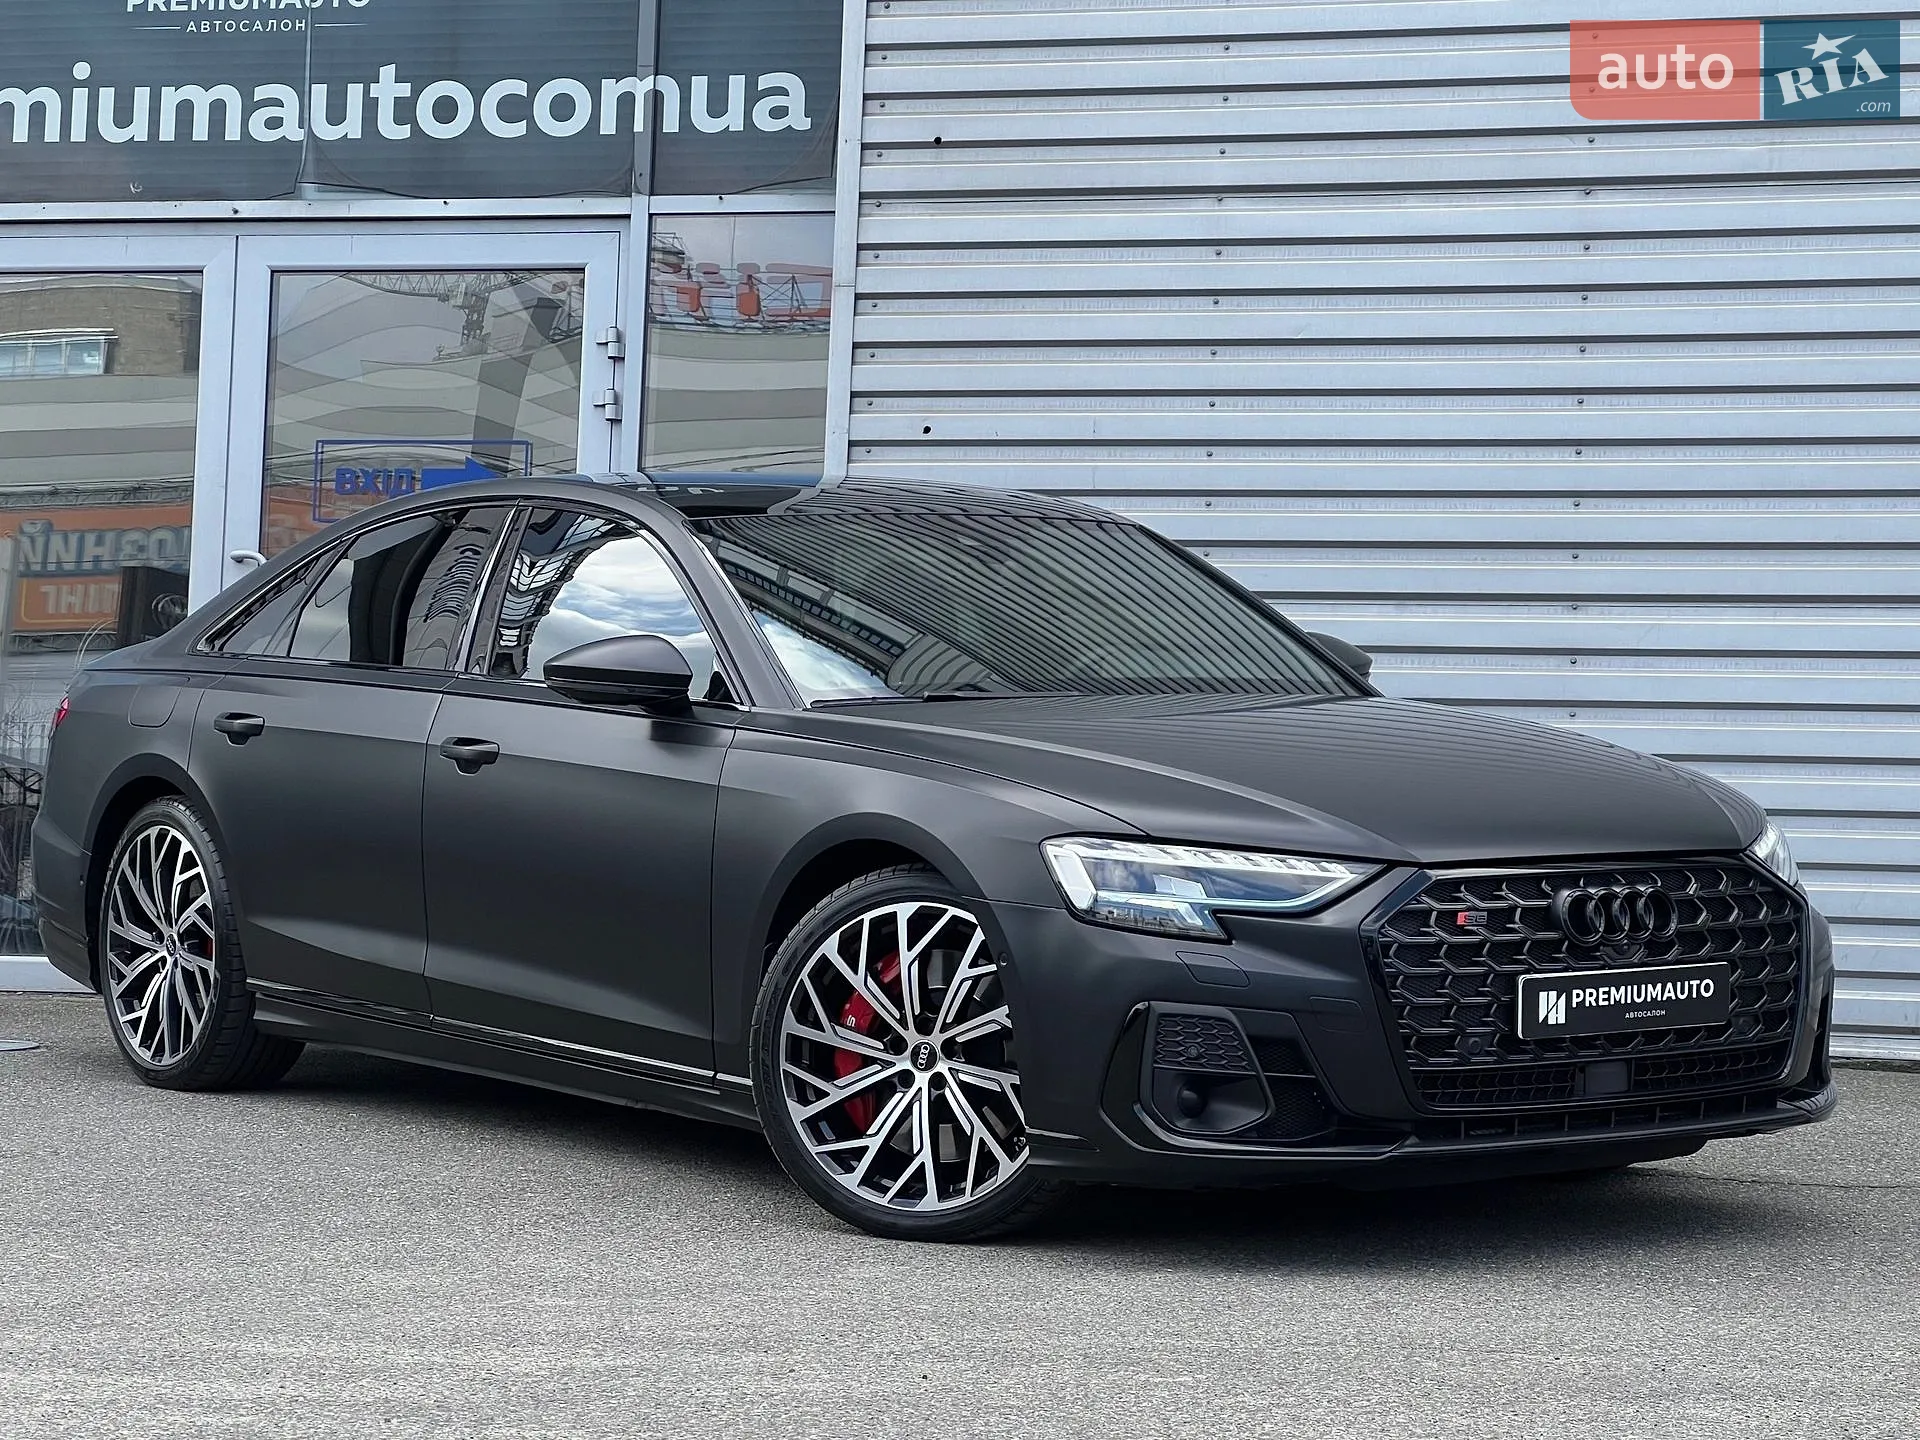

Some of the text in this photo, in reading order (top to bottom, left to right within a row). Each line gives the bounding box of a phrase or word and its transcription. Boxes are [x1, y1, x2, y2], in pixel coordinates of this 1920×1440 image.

[186, 19, 306, 33] АВТОСАЛОН
[1571, 978, 1715, 1008] PREMIUMAUTO
[1624, 1009, 1666, 1019] АВТОСАЛОН
